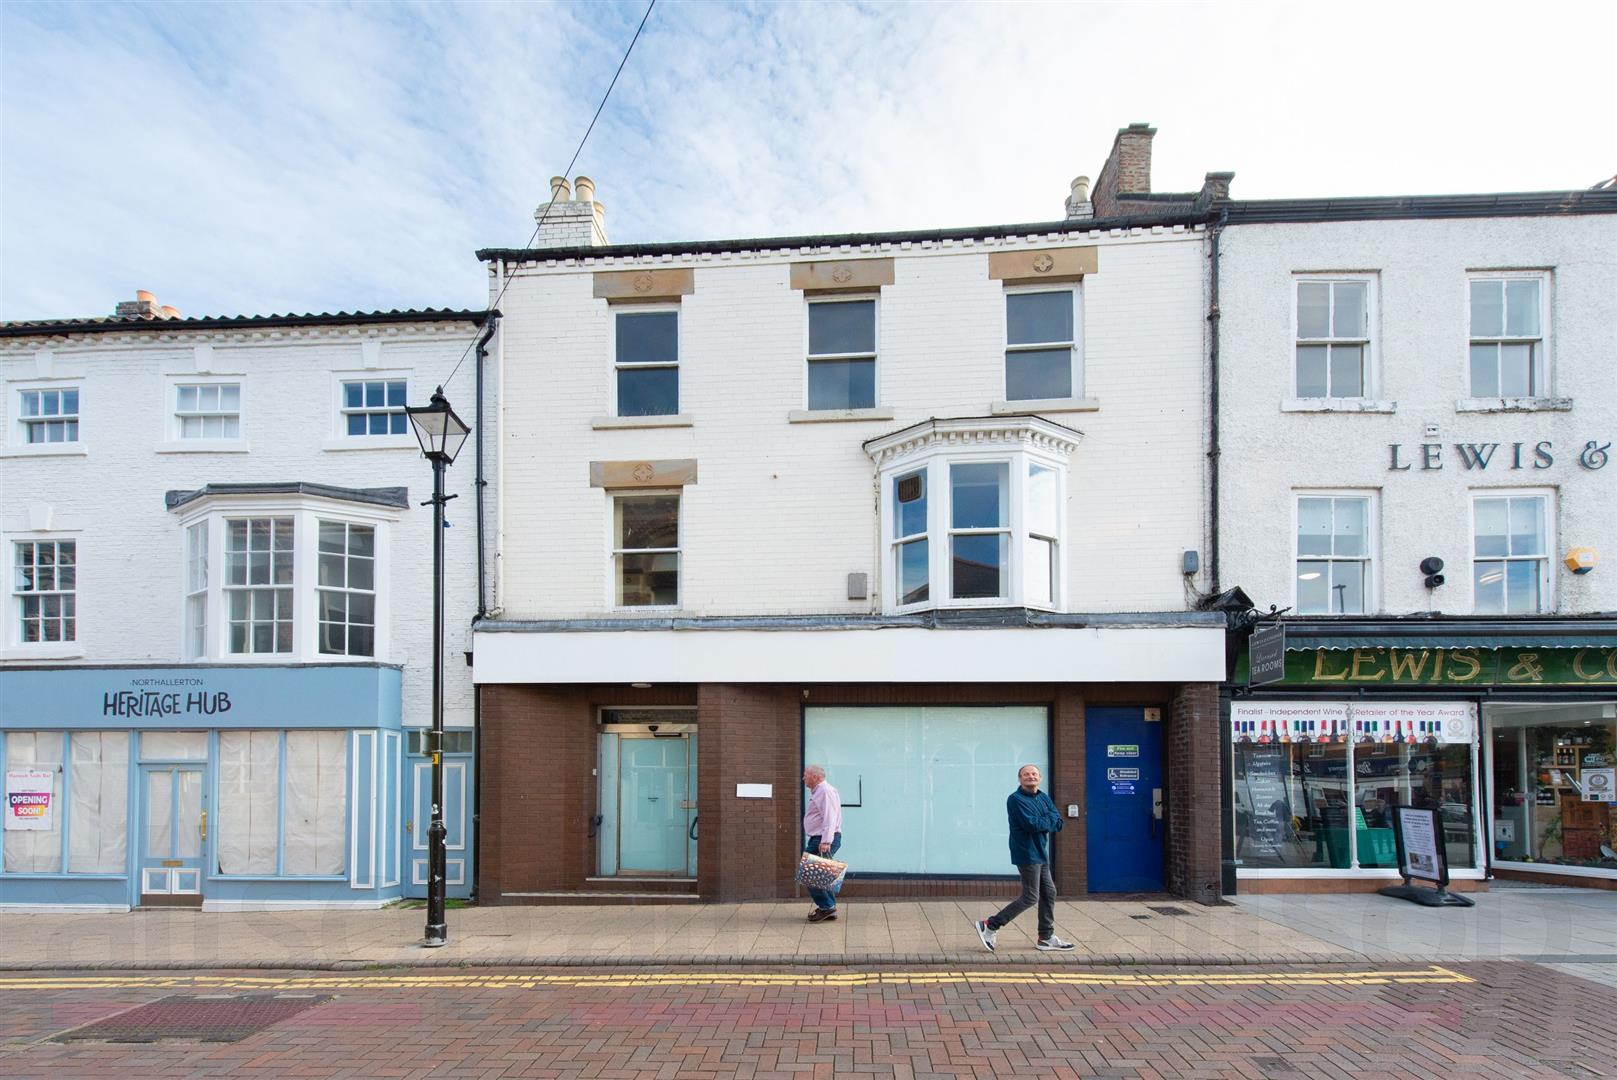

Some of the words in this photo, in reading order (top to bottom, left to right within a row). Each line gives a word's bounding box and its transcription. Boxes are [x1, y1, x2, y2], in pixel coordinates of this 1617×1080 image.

[1387, 440, 1554, 471] LEWIS
[1579, 440, 1612, 471] &
[1251, 665, 1261, 675] TEA
[1261, 658, 1282, 673] ROOMS
[1312, 648, 1481, 681] LEWIS
[1507, 653, 1544, 681] &
[186, 690, 232, 715] HUB
[1269, 708, 1321, 716] Independent
[11, 795, 48, 804] OPENING
